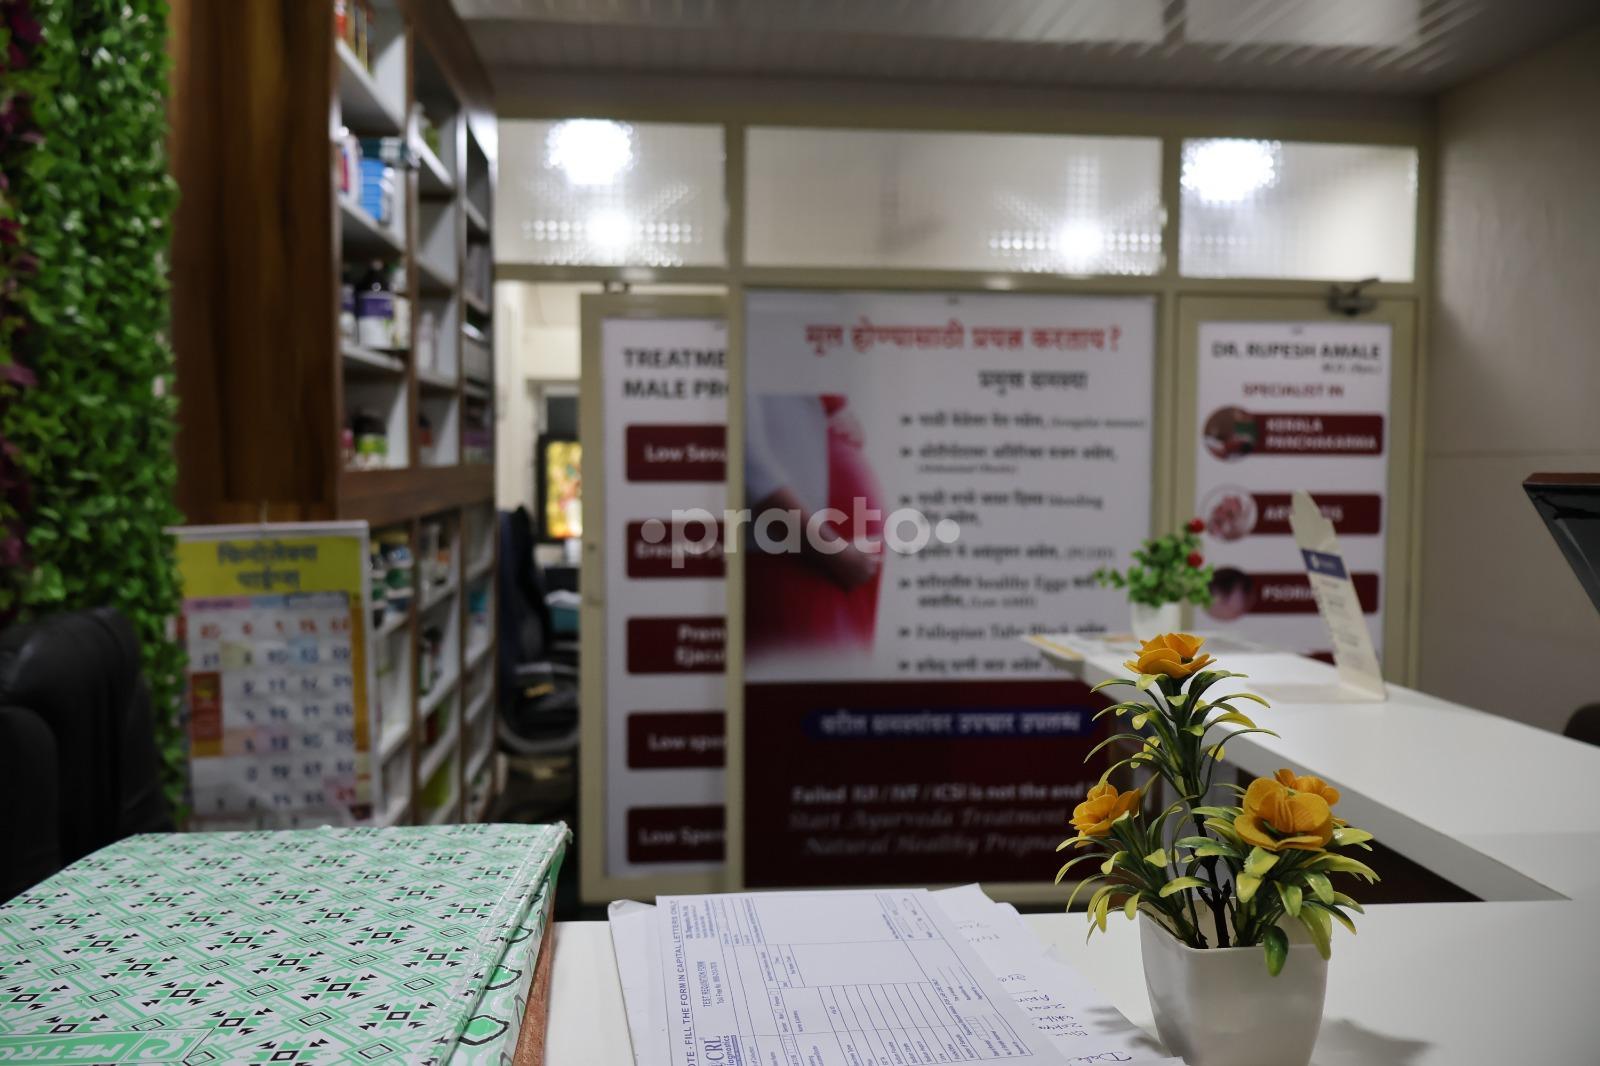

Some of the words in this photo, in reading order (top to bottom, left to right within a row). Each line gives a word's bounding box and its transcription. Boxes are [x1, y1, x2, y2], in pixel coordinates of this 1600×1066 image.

[623, 379, 685, 399] MALE
[644, 443, 682, 461] Low
[671, 916, 681, 943] LETTERS
[675, 945, 685, 973] CAPITAL
[679, 983, 689, 1004] FORM
[682, 1006, 692, 1025] THE
[685, 1027, 693, 1045] FILL
[704, 1036, 724, 1061] CRL
